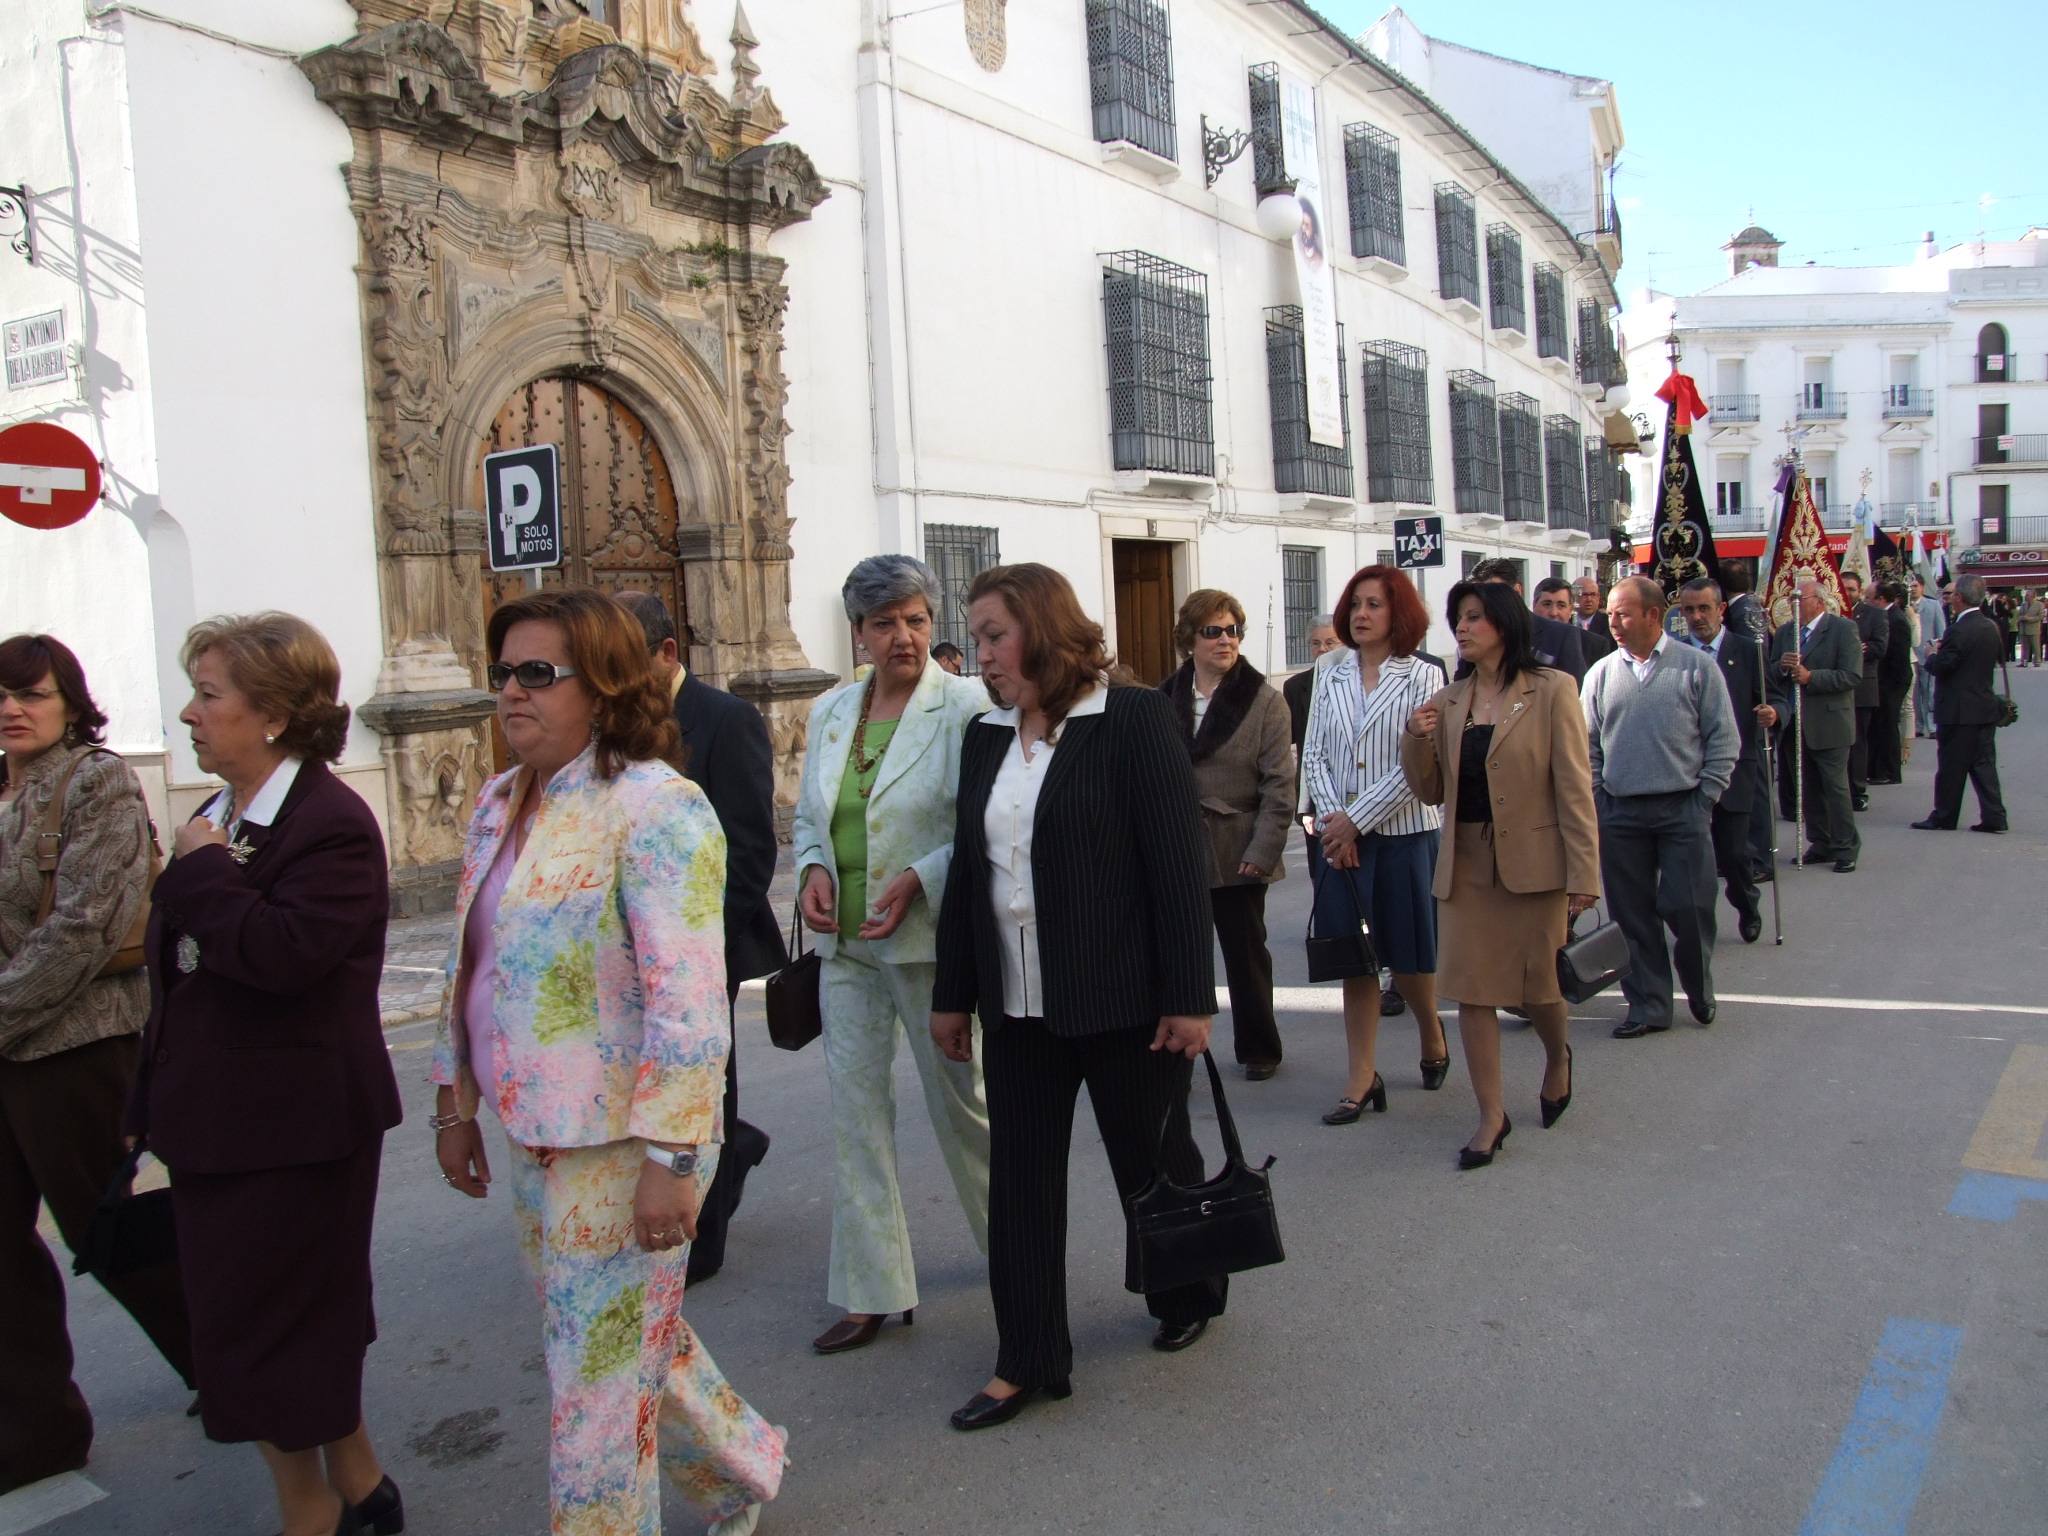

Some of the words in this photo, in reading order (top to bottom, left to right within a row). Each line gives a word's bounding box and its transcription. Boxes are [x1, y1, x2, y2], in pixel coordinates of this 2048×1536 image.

[25, 319, 59, 348] ANTONIO
[9, 360, 20, 384] DE
[21, 358, 32, 381] LA
[499, 464, 542, 556] P
[524, 524, 549, 539] SOLO
[1396, 533, 1441, 552] TAXI
[520, 538, 553, 553] MOTOS
